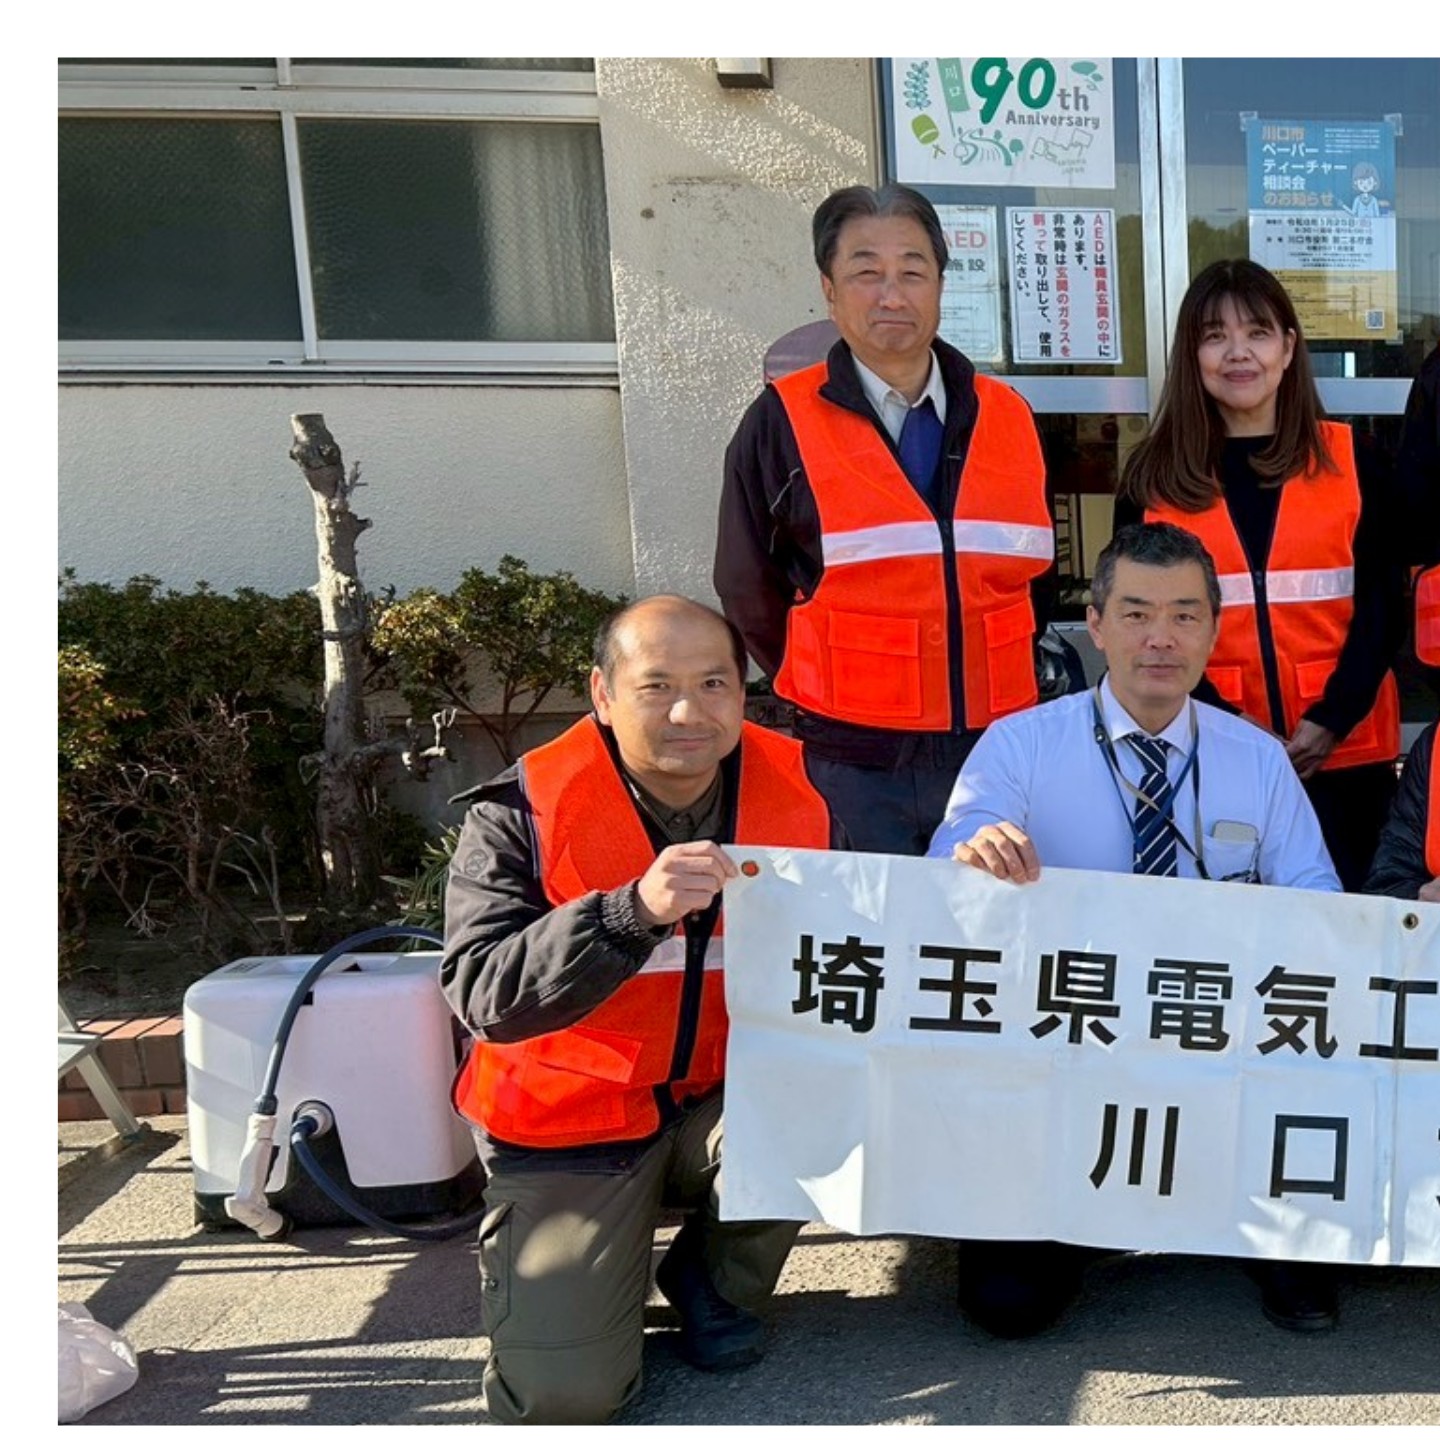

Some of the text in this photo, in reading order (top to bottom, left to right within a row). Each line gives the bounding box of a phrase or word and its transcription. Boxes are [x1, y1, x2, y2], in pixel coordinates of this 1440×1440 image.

[1006, 110, 1100, 130] Anniversary
[1262, 126, 1305, 141] 川口市
[1262, 143, 1319, 157] ペーパー
[1263, 159, 1348, 175] ティーチャー
[1263, 175, 1306, 190] 相談会
[1263, 191, 1333, 207] のお知らせ
[1073, 214, 1088, 271] あります。
[1014, 213, 1031, 297] してください。
[1053, 214, 1071, 357] 非常時は玄関のガラスを
[1093, 214, 1111, 357] AEDは職員玄関の中に
